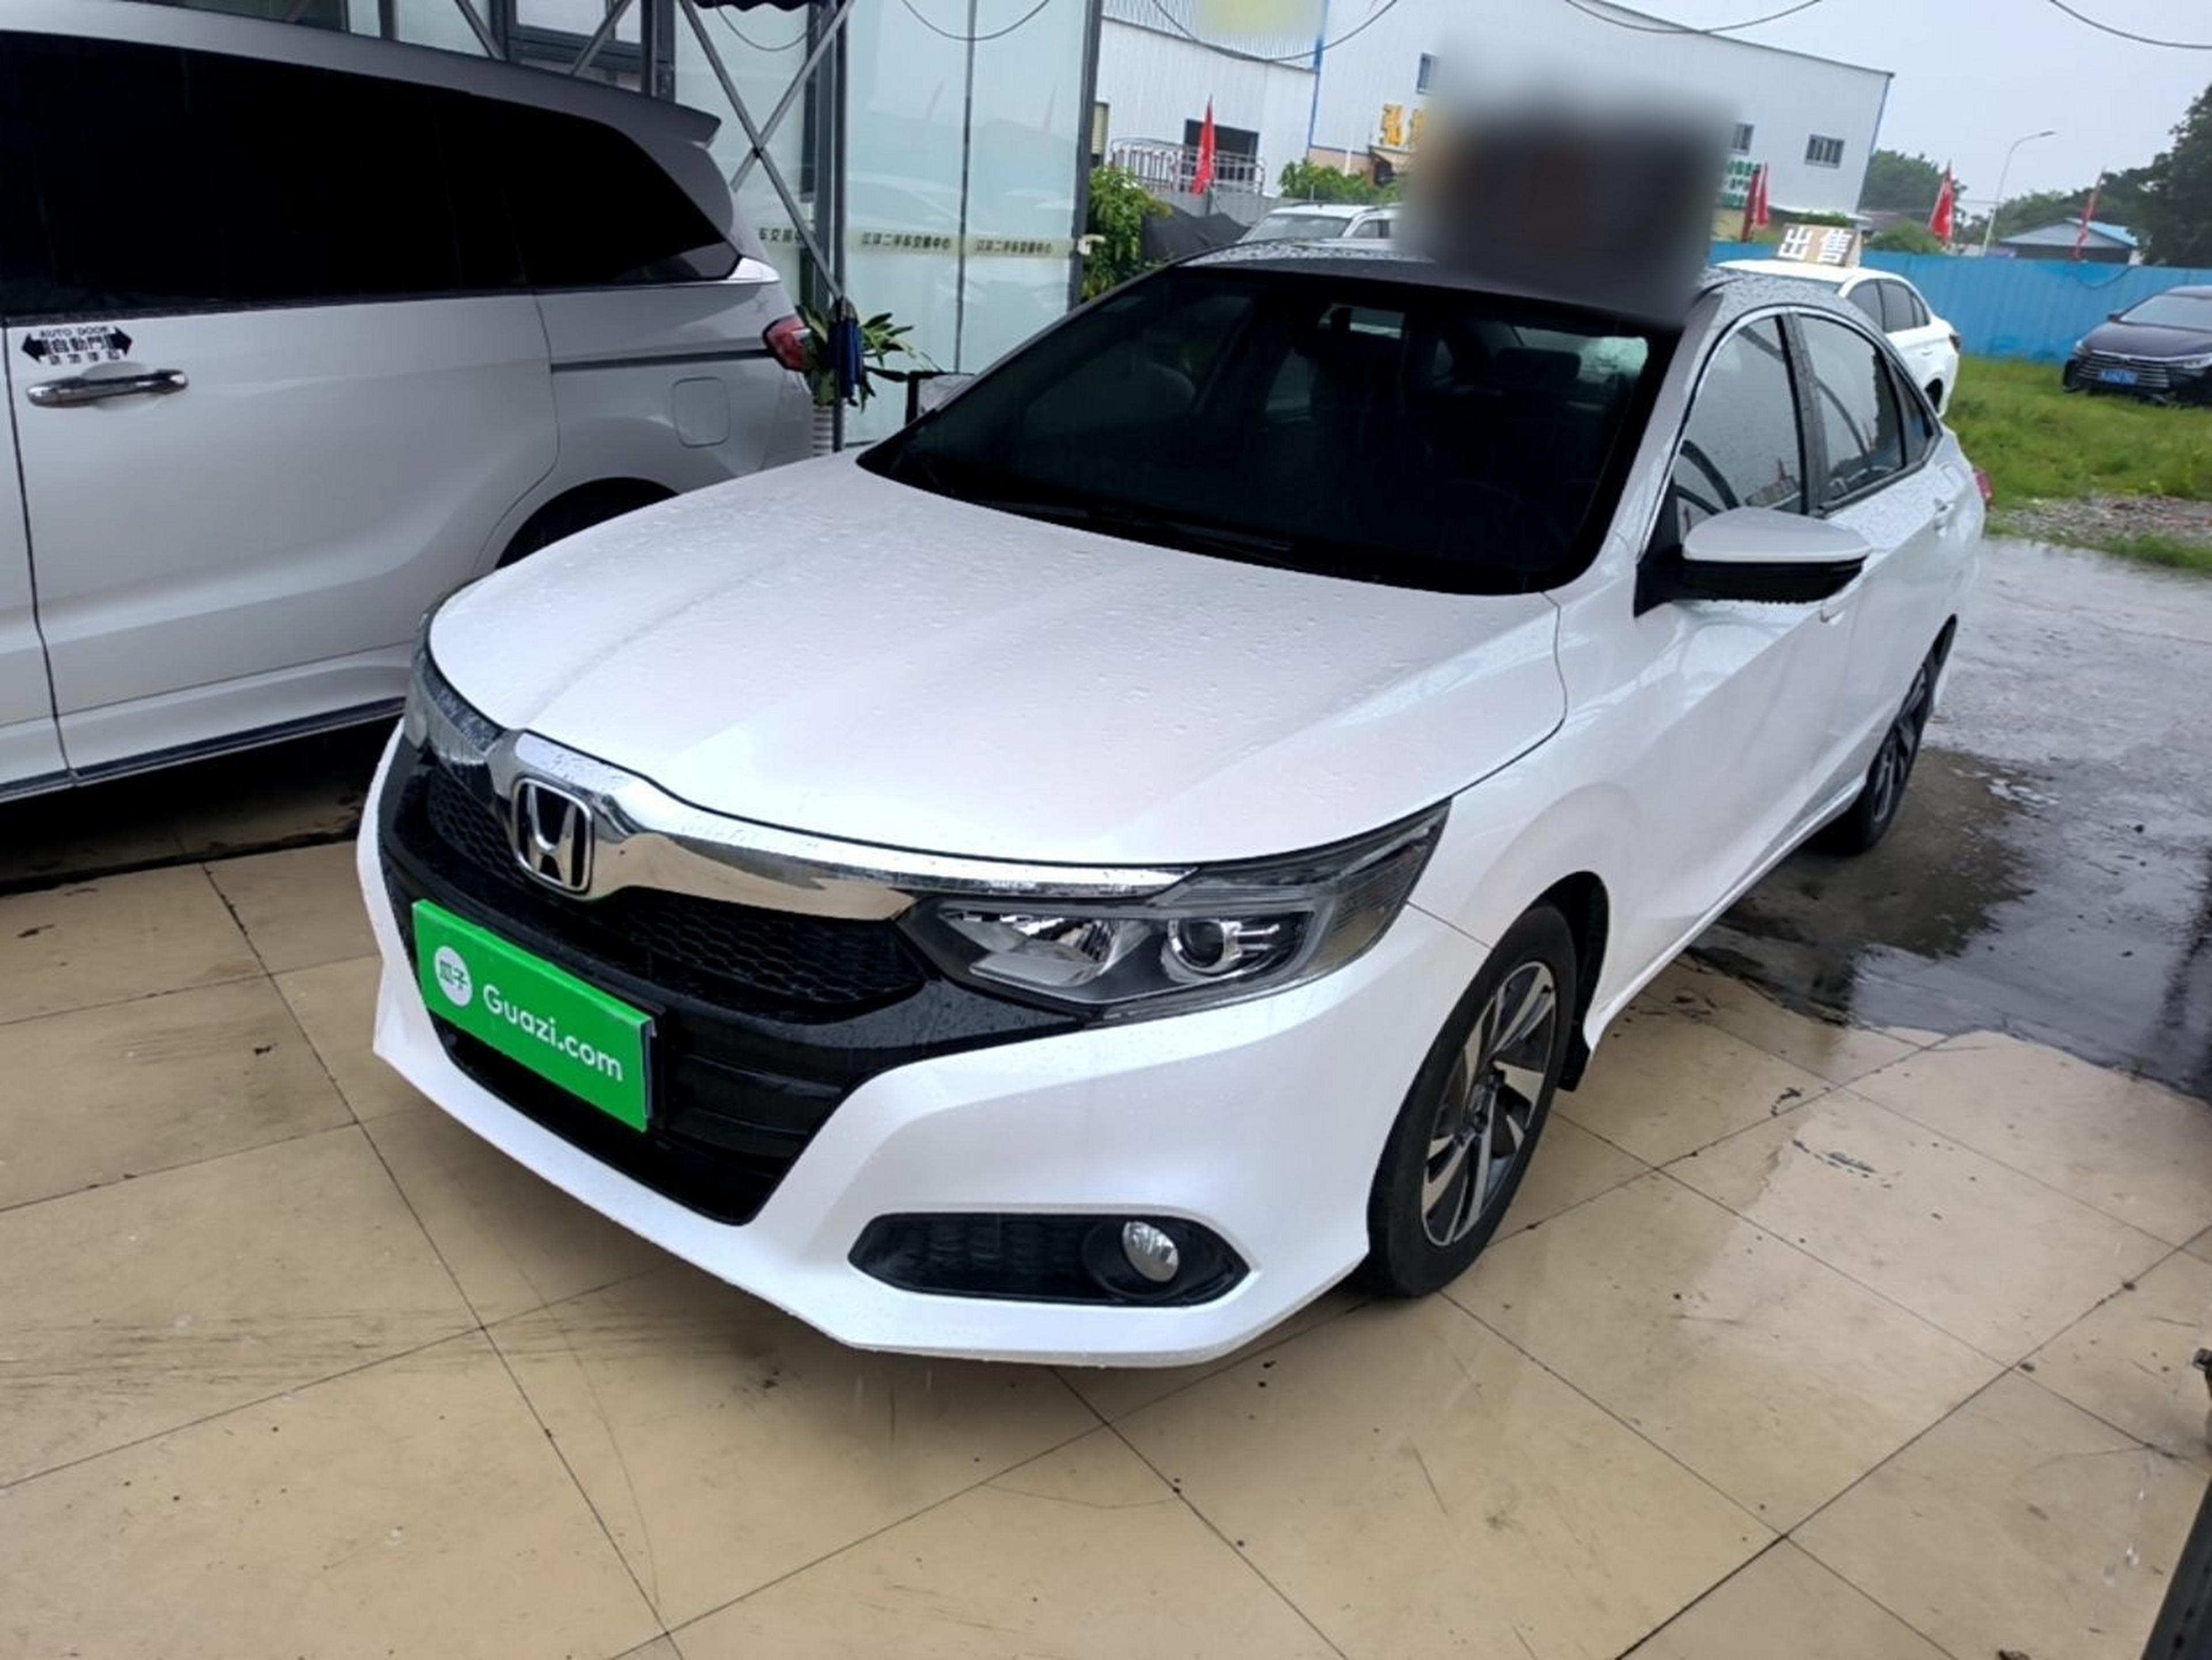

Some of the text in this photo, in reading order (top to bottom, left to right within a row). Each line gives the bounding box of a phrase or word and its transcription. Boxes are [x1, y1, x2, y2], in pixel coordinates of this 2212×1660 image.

[1778, 225, 1852, 263] 出售
[39, 326, 108, 338] AUTO DOOR
[483, 984, 623, 1082] Guazi.com
